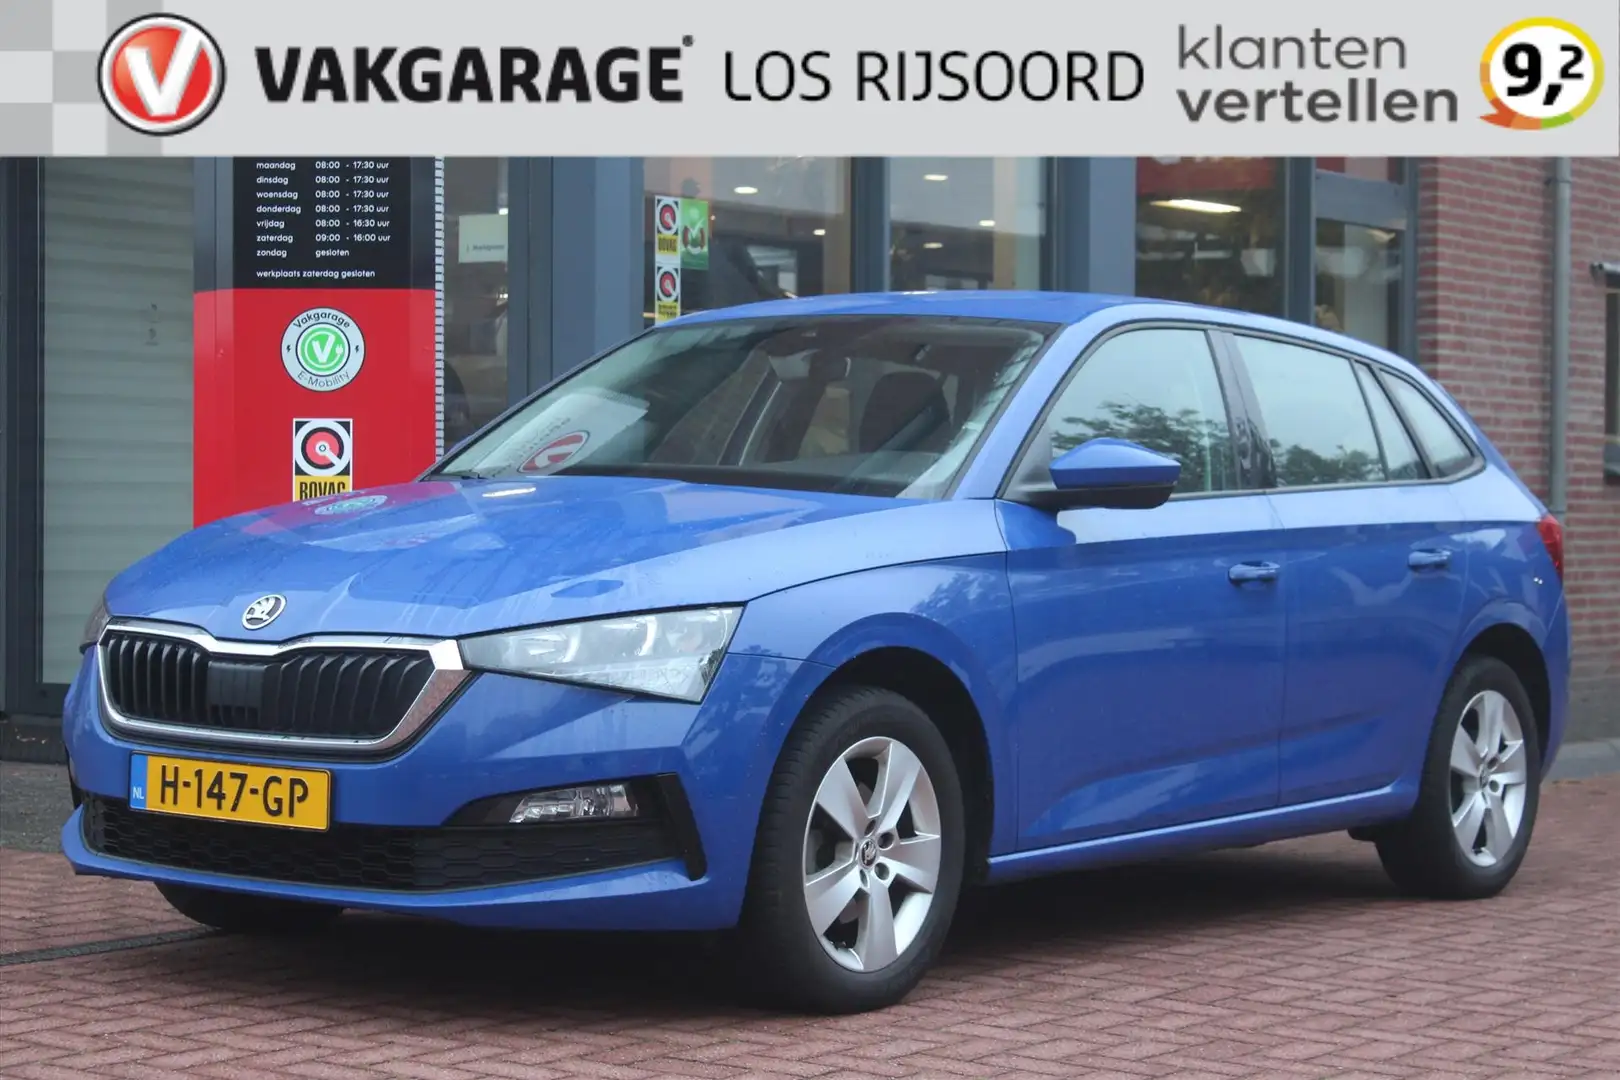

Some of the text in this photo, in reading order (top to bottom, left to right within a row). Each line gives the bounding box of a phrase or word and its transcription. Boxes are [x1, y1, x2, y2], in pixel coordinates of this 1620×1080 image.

[256, 161, 296, 171] maandag
[315, 160, 341, 169] 08:00
[352, 160, 375, 169] 17:30
[256, 175, 289, 185] dinsdag
[315, 175, 341, 184] 08:00
[352, 175, 375, 184] 17:30
[256, 190, 298, 200] woensdag
[315, 189, 341, 198] 08:00
[352, 189, 375, 198] 17:30
[256, 205, 301, 214] donderdag
[315, 204, 341, 213] 08:00
[352, 204, 375, 213] 17:30
[256, 219, 285, 229] vrijdag
[315, 219, 341, 228] 08:00
[352, 219, 376, 228] 16:30
[256, 234, 294, 243] zaterdag
[315, 233, 341, 242] 09:00
[352, 233, 376, 242] 16:00
[256, 248, 350, 258] zondag gesloten
[256, 269, 376, 280] werkplaats zaterdag gesloten
[293, 310, 351, 329] Vakgarage
[297, 369, 350, 388] E-Mobility
[132, 786, 145, 801] NL
[160, 763, 310, 819] H-147-GP
